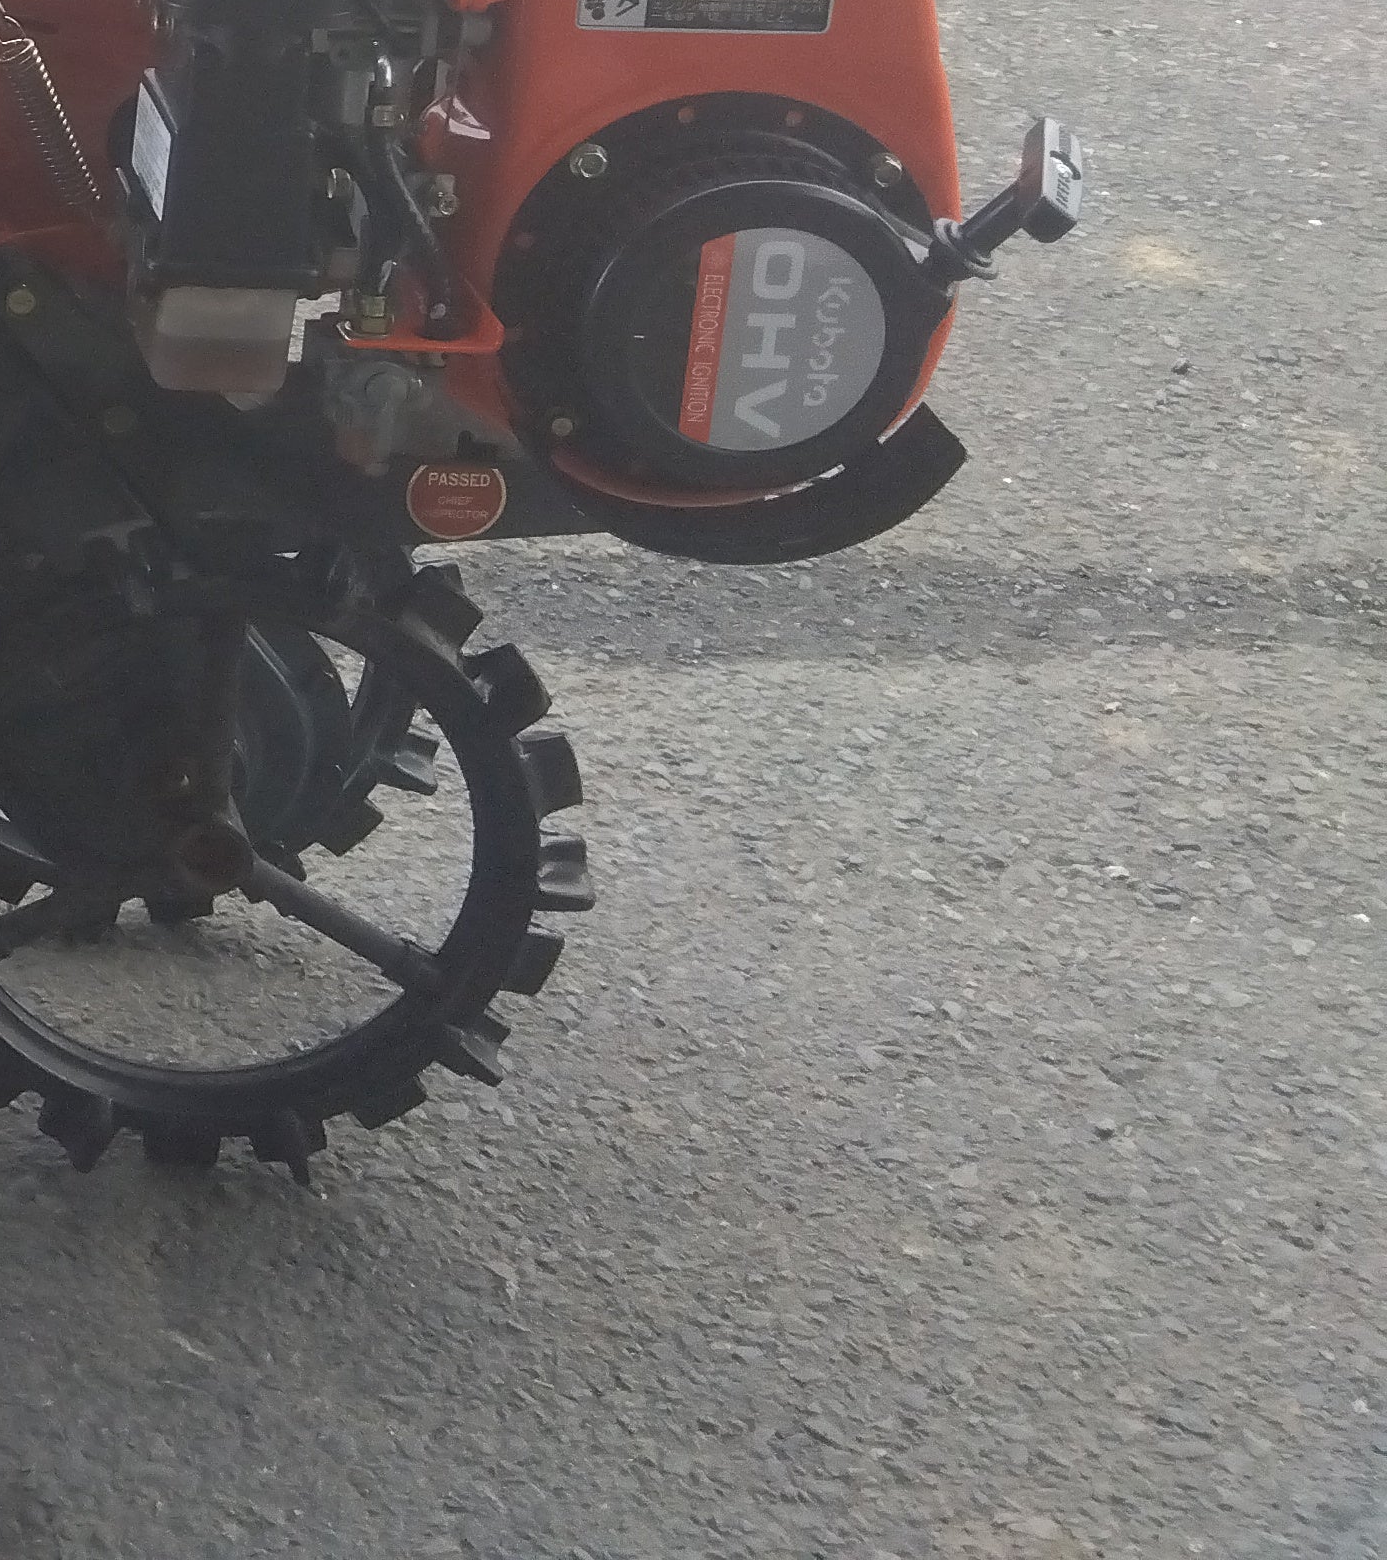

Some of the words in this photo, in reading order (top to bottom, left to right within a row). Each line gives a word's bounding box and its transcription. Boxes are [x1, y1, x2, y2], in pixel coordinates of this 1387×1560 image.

[695, 274, 725, 353] ELECTRONIC
[734, 241, 805, 438] OHV
[803, 276, 852, 407] Kubota
[687, 361, 713, 423] IGNITION
[428, 472, 491, 487] PASSED
